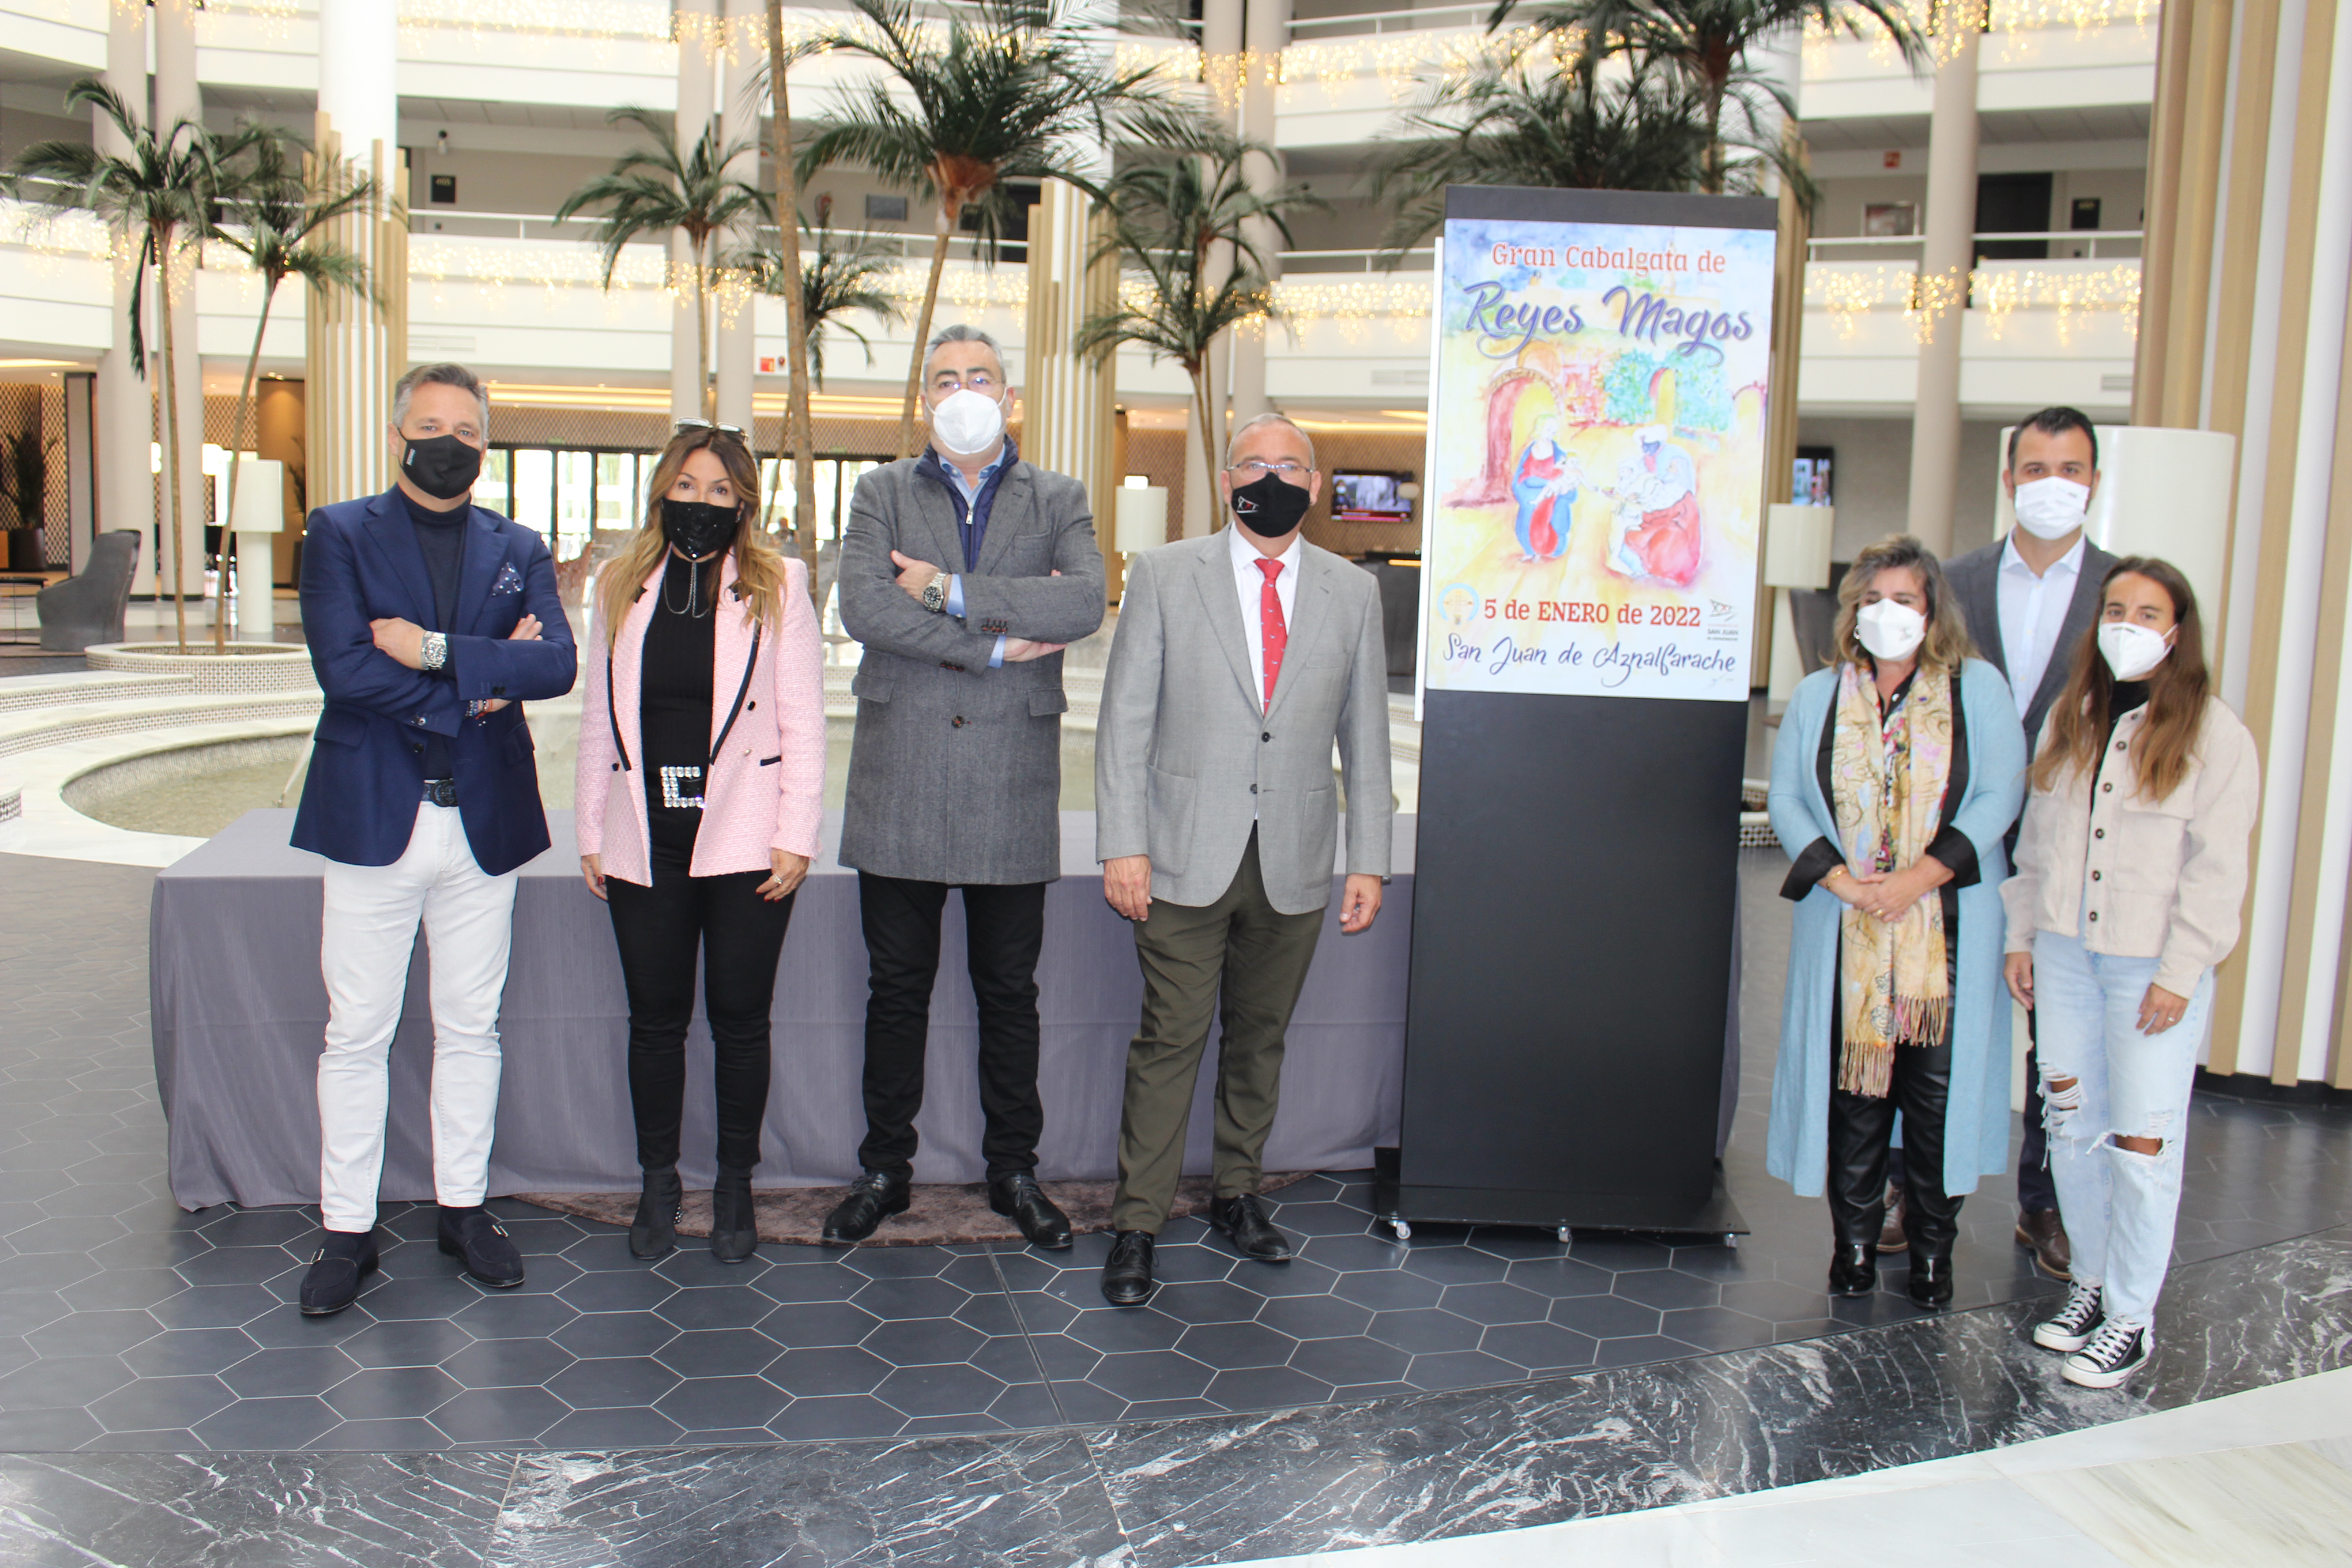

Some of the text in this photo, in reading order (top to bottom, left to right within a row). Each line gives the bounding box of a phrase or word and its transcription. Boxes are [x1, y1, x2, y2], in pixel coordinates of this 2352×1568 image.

[1492, 243, 1727, 276] Gran Cabalgata de
[1463, 280, 1754, 368] Reyes Magos
[1484, 598, 1701, 627] 5 de ENERO de 2022
[1442, 632, 1482, 663] San
[1489, 636, 1548, 675] Juan
[1557, 642, 1583, 666] de
[1592, 641, 1736, 688] Aznalfarache
